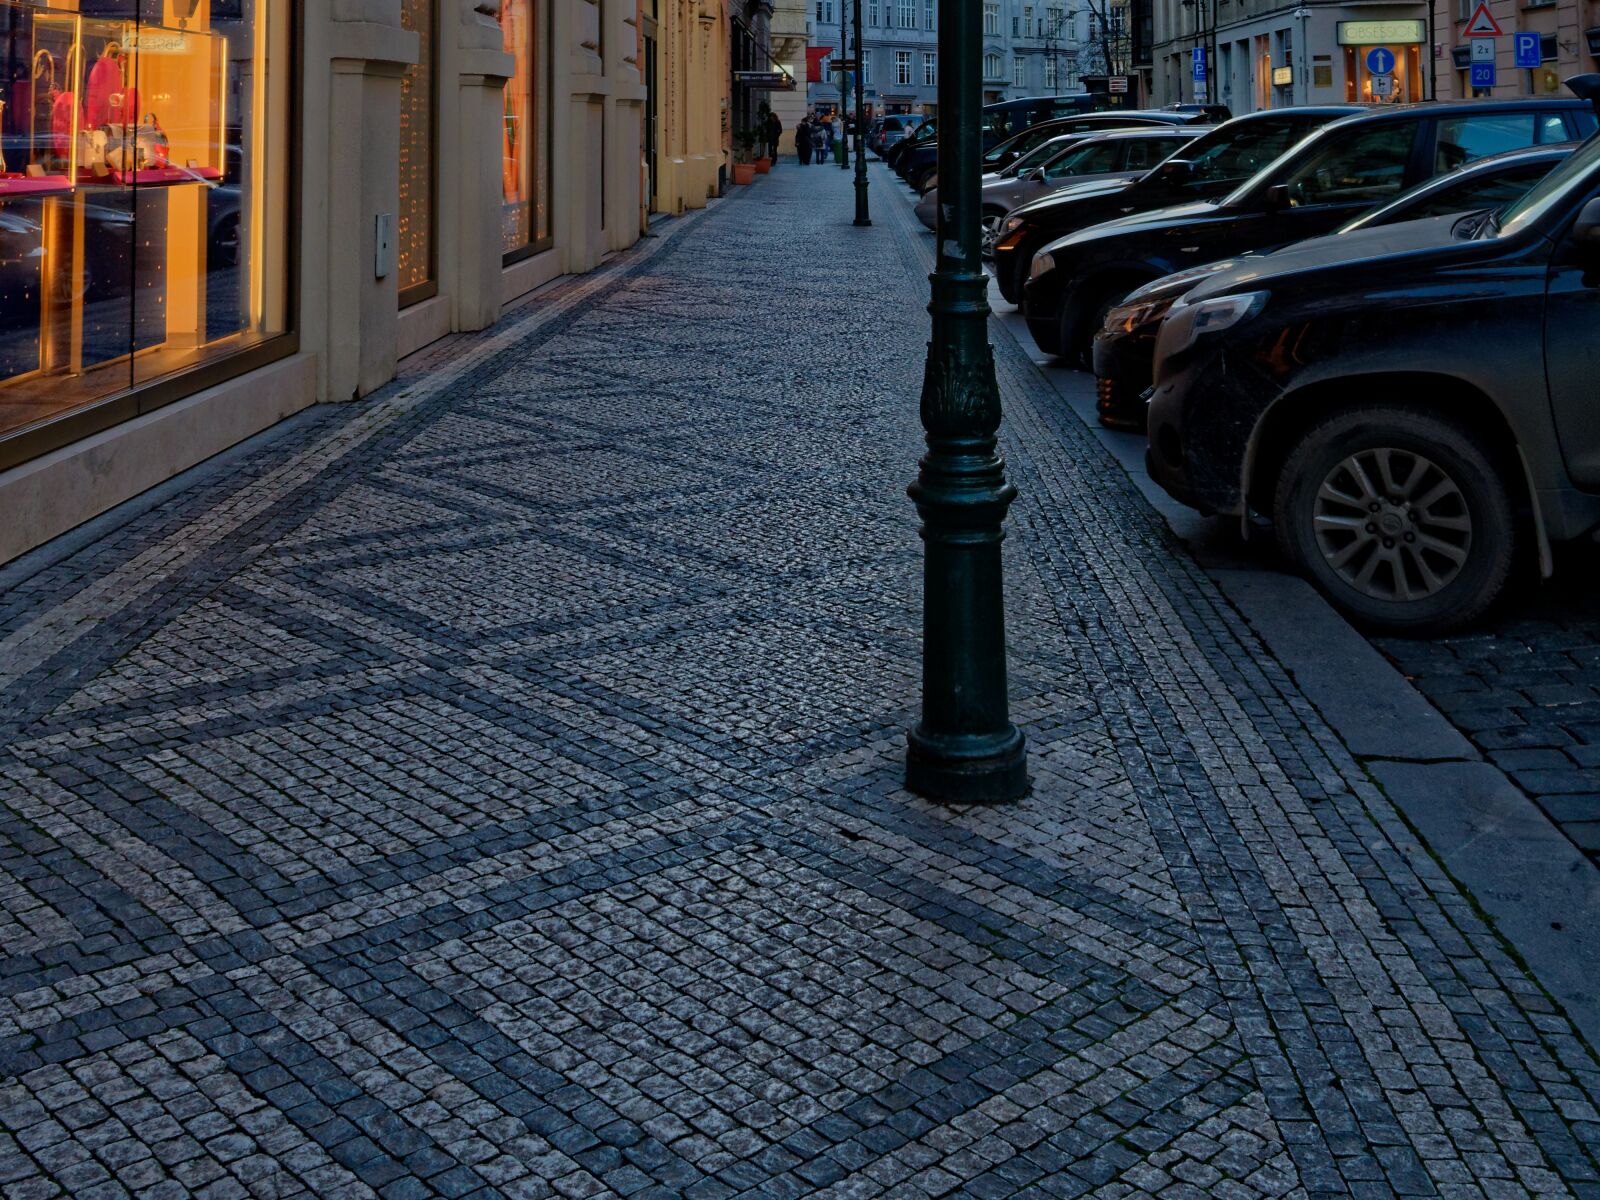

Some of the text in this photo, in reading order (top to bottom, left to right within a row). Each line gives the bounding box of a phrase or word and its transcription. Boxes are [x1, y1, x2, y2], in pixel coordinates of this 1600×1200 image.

[1346, 24, 1418, 39] OBSESSION
[1520, 36, 1534, 56] P
[1196, 64, 1203, 75] P
[1475, 69, 1490, 80] 20
